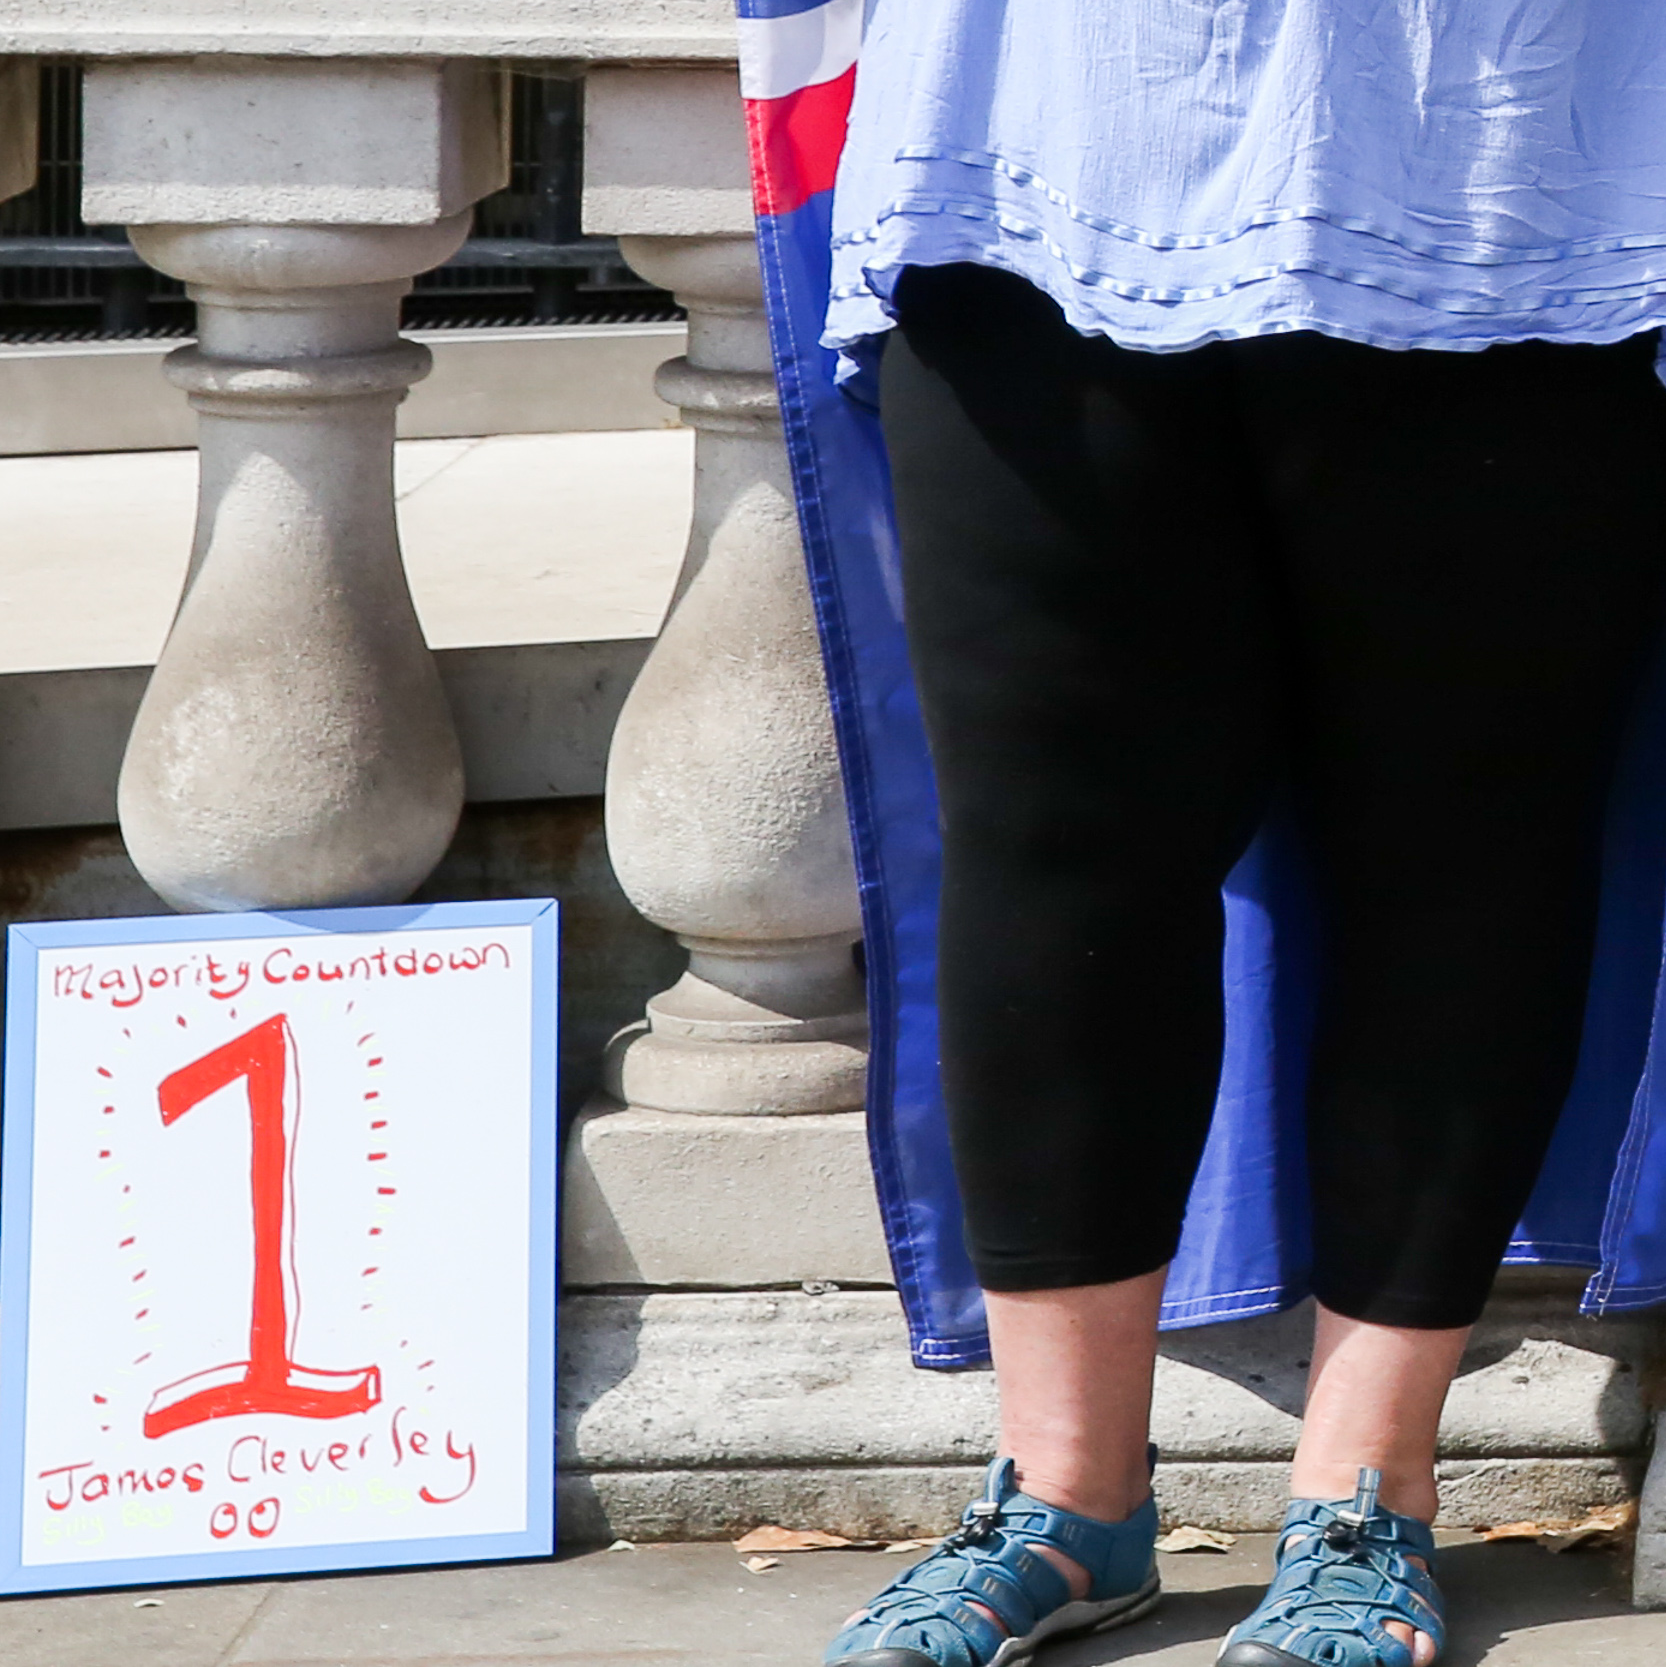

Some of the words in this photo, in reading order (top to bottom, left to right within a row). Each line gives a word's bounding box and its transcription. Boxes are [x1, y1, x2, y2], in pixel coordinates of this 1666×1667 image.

[54, 953, 250, 1007] Majority
[263, 942, 511, 984] Countdown
[144, 1012, 382, 1439] 1
[228, 1406, 477, 1504] Cleverley
